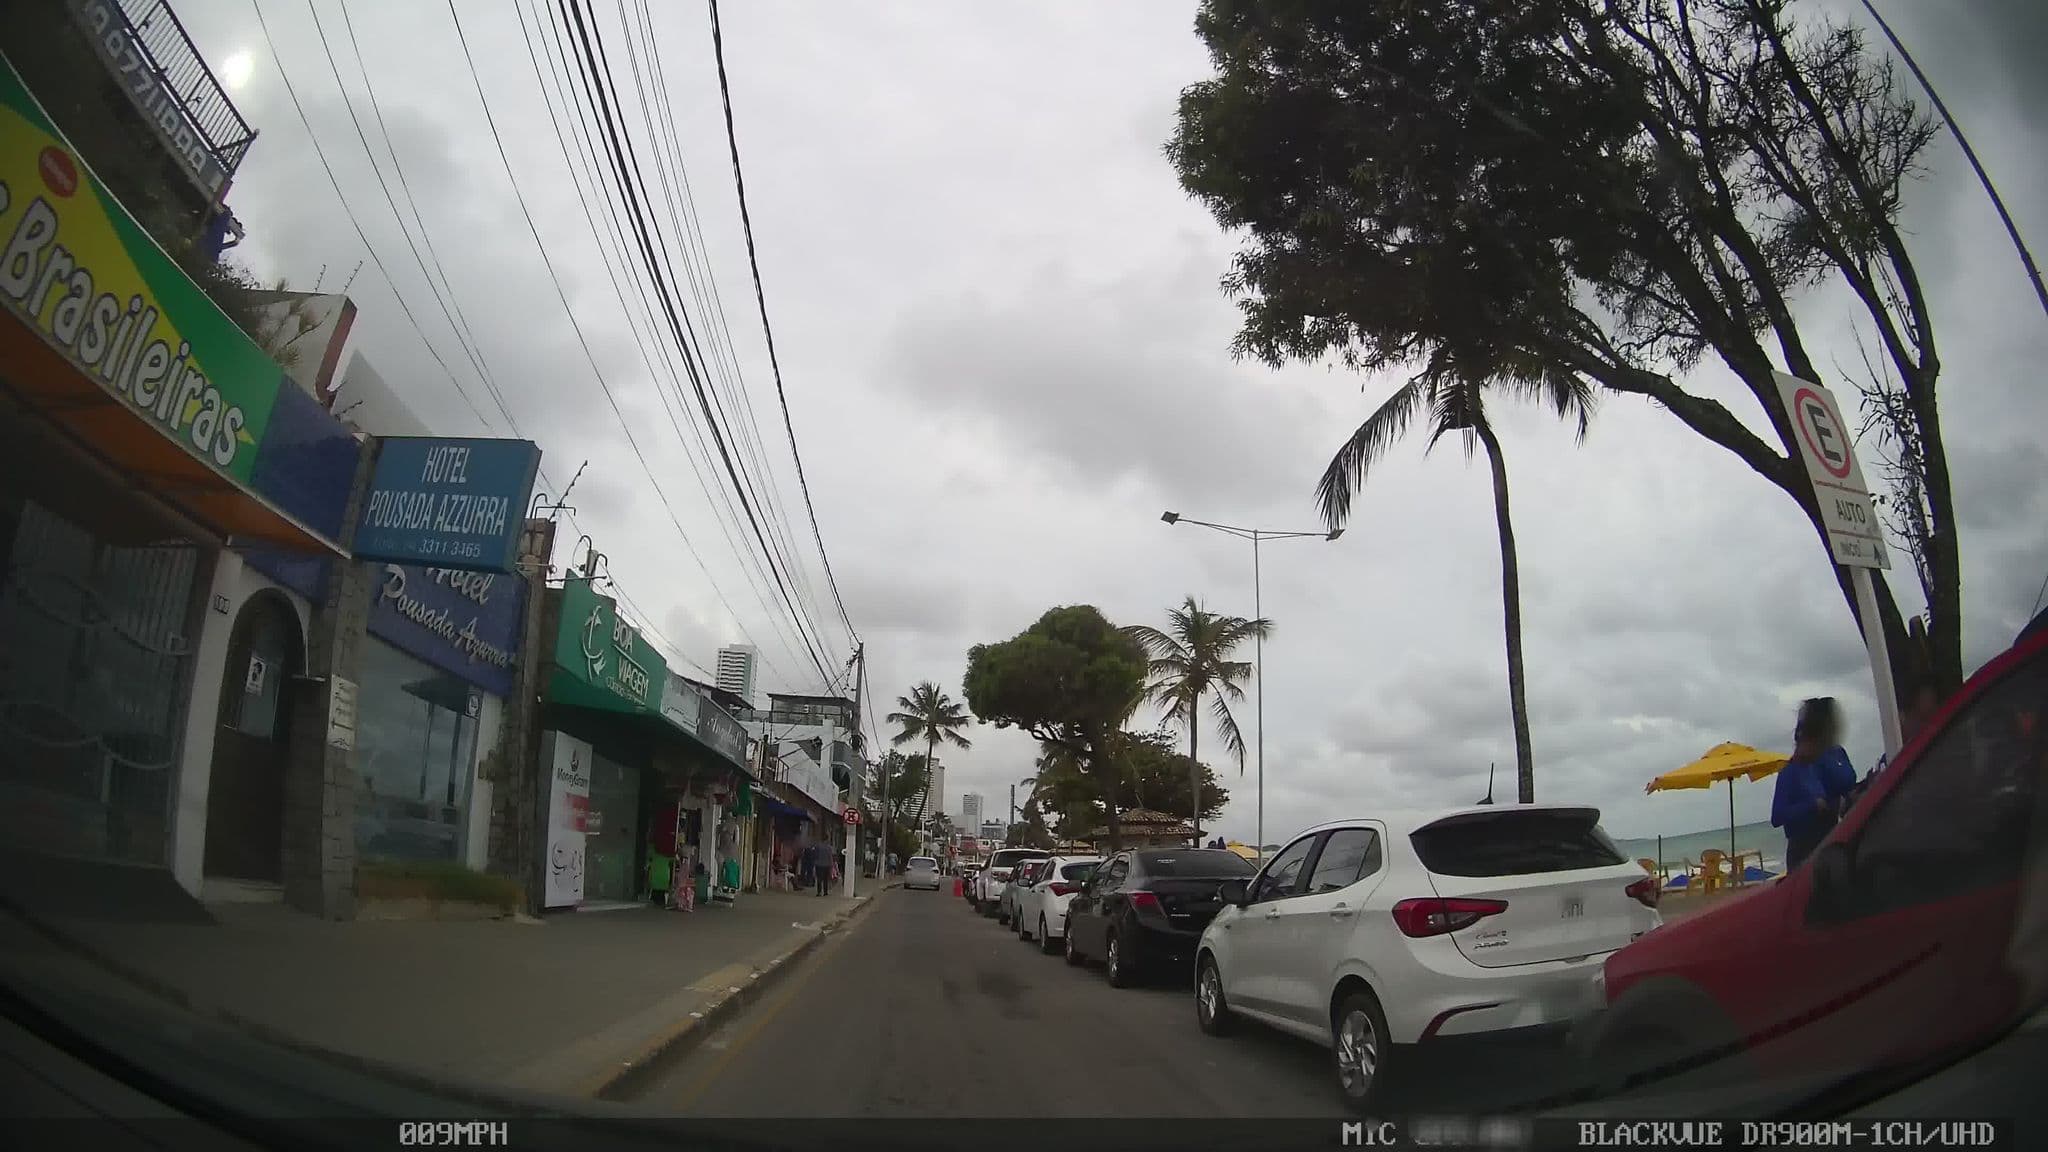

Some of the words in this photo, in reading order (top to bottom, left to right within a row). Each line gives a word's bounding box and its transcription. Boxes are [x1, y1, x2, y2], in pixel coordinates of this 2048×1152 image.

[1, 197, 244, 467] Brasileiras
[1806, 402, 1842, 463] E
[421, 447, 471, 484] HOTEL
[365, 489, 436, 531] POUSADA
[433, 494, 509, 537] AZZURRA
[1835, 498, 1866, 524] AUTO
[380, 563, 456, 640] Pousada
[613, 616, 633, 653] BOA
[618, 655, 649, 701] VIAGEM
